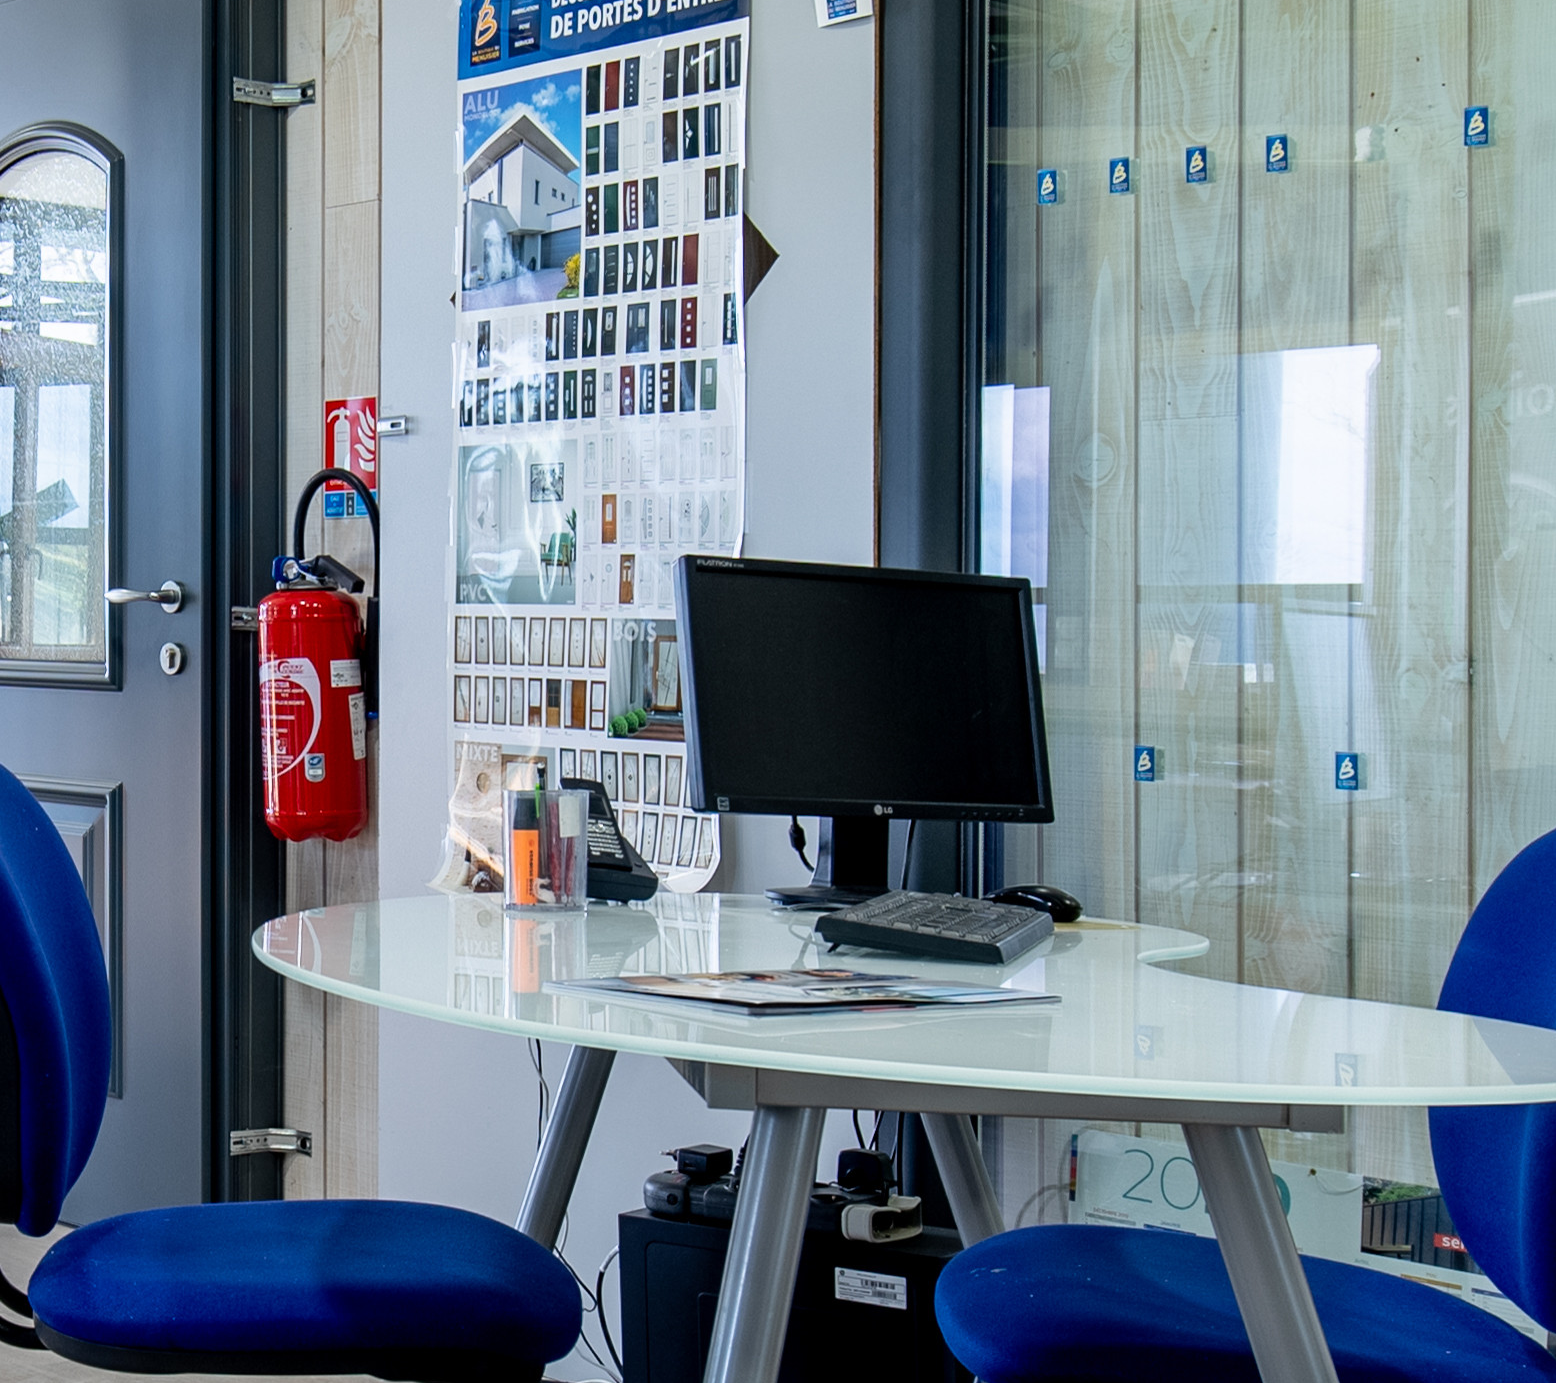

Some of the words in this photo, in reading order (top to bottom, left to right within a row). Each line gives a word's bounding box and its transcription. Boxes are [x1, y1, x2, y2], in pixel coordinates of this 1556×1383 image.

[550, 14, 574, 39] DE
[464, 89, 499, 115] ALU
[696, 558, 733, 568] FLATRON
[459, 583, 488, 602] PVC
[612, 621, 657, 643] BOIS
[455, 745, 499, 764] MIXTE
